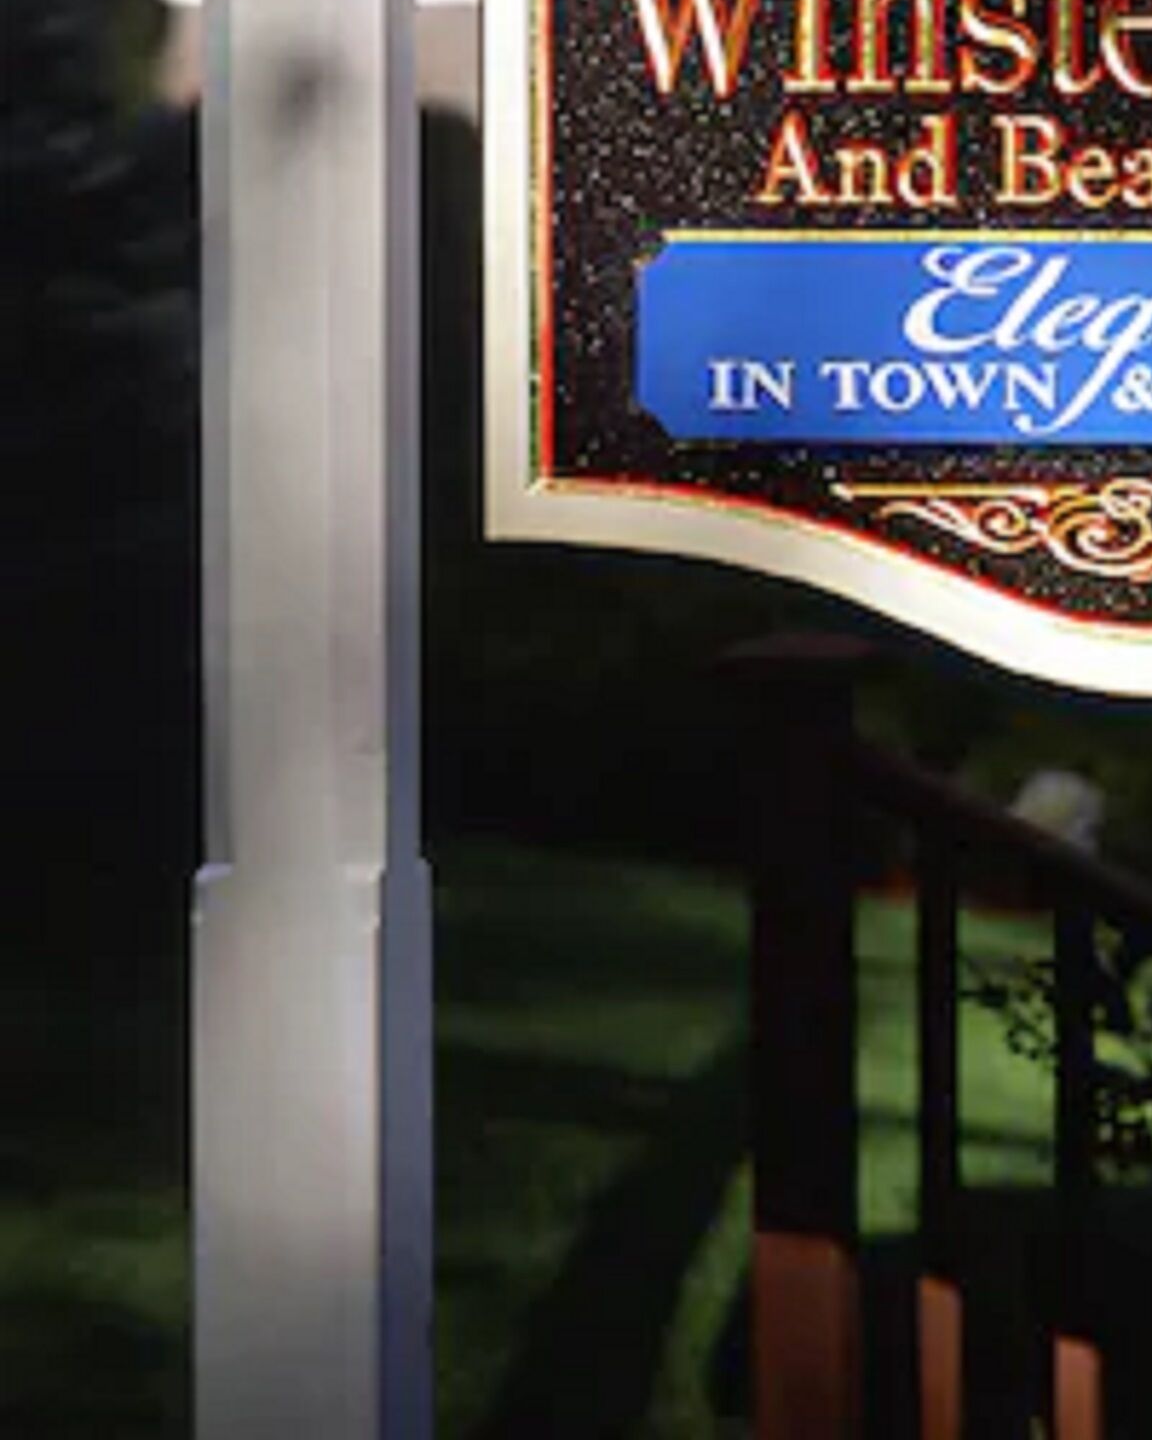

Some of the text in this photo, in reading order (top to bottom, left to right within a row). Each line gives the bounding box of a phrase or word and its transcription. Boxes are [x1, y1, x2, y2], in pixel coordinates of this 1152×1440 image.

[756, 114, 958, 210] And
[707, 359, 794, 412] IN
[820, 361, 1061, 413] TOWN
